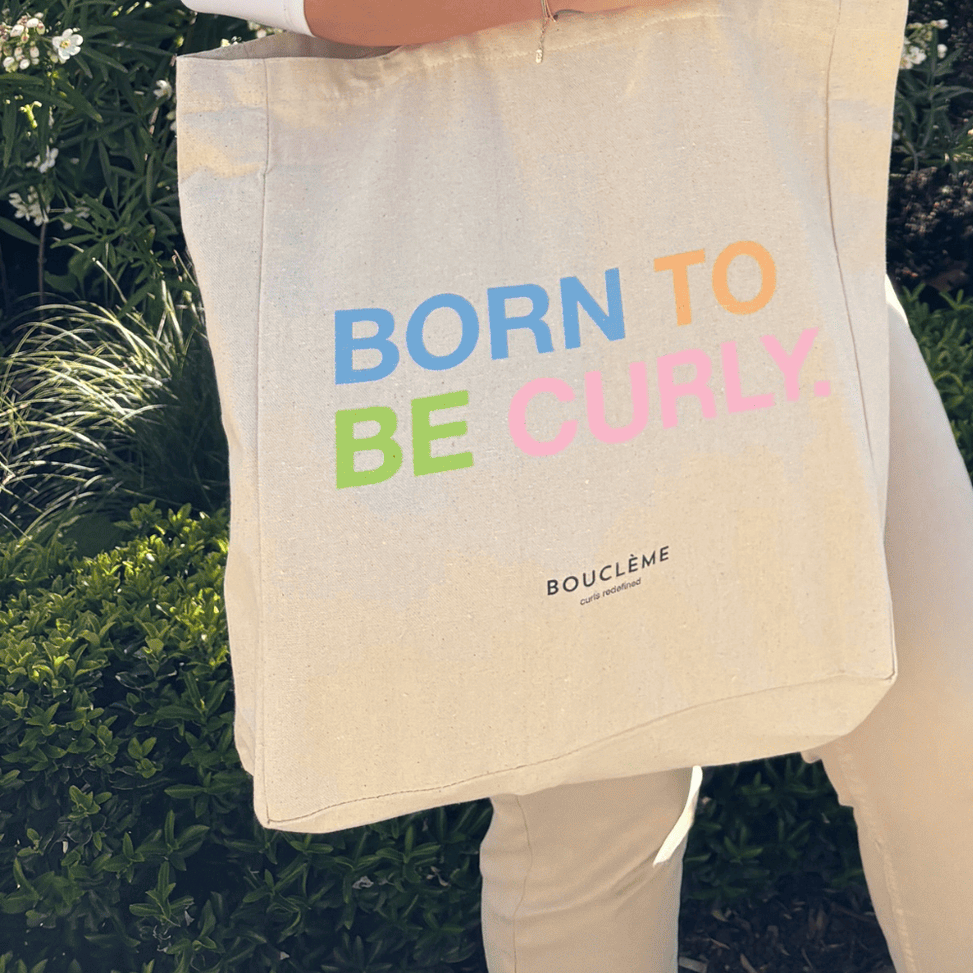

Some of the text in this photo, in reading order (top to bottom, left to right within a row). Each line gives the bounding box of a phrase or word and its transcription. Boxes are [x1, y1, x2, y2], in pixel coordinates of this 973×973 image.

[334, 240, 777, 385] BORN TO
[335, 327, 832, 490] BE CURLY.
[546, 545, 670, 596] BOUCLÈME
[579, 577, 642, 606] curls redefined
